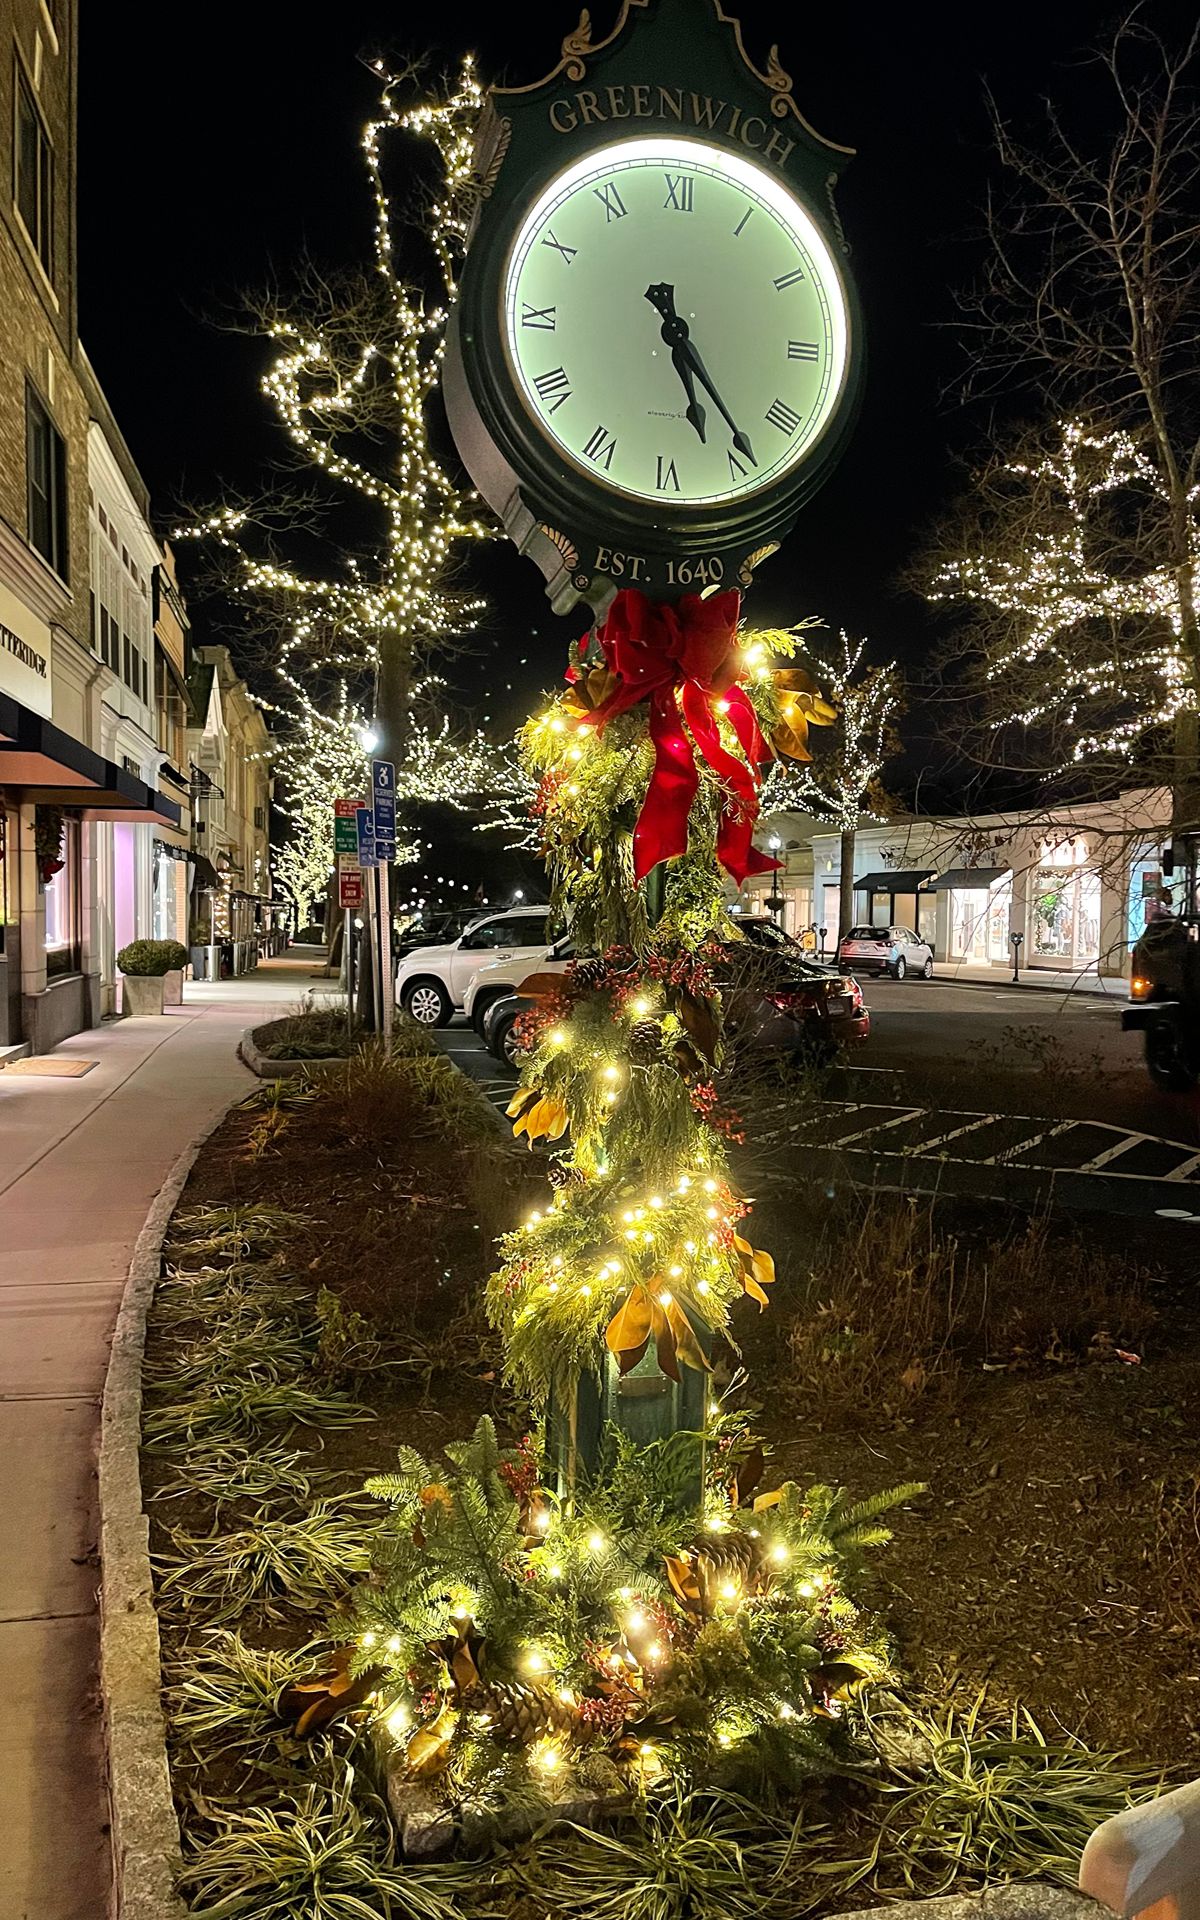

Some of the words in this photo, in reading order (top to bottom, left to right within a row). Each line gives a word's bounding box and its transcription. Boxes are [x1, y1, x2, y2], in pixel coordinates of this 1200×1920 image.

[549, 85, 797, 169] GREENWICH
[592, 181, 628, 223] XI
[664, 174, 695, 212] XII
[733, 207, 755, 237] I
[541, 229, 578, 265] X
[773, 268, 805, 292] II
[522, 302, 556, 331] IX
[788, 340, 819, 362] III
[532, 366, 573, 416] VIII
[582, 425, 618, 471] VII
[727, 449, 749, 482] V
[656, 456, 681, 492] VI
[594, 546, 652, 581] EST.
[665, 557, 724, 585] 1640
